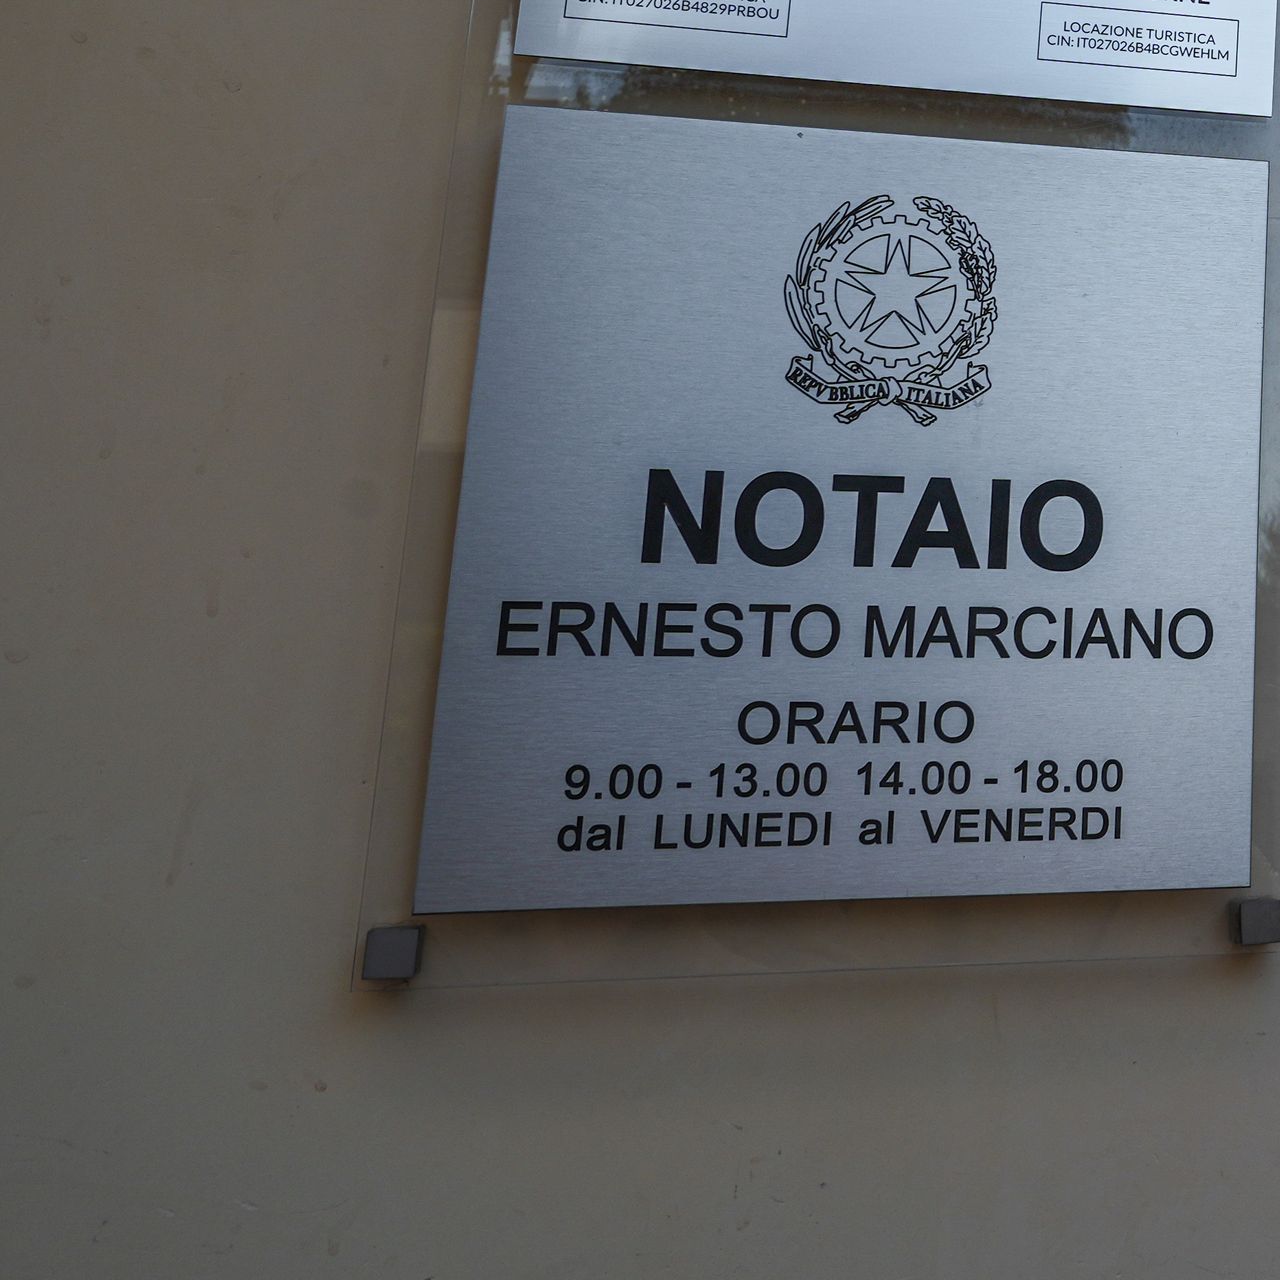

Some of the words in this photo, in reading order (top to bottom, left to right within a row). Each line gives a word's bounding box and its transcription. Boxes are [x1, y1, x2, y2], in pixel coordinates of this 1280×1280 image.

[1046, 34, 1075, 48] CIN:
[1063, 20, 1144, 39] LOCAZIONE
[1146, 28, 1216, 46] TURISTICA
[906, 377, 985, 408] ITALIANA
[640, 467, 1106, 573] NOTAIO
[495, 600, 841, 659] ERNESTO
[863, 605, 1215, 661] MARCIANO
[736, 700, 977, 746] ORARIO
[563, 764, 663, 801] 9.00
[707, 761, 829, 799] 13.00
[856, 760, 973, 797] 14.00
[1013, 758, 1126, 795] 18.00
[556, 814, 626, 853] dal
[653, 811, 833, 850] LUNEDI
[859, 808, 895, 846] al
[920, 807, 1123, 845] VENERDI
